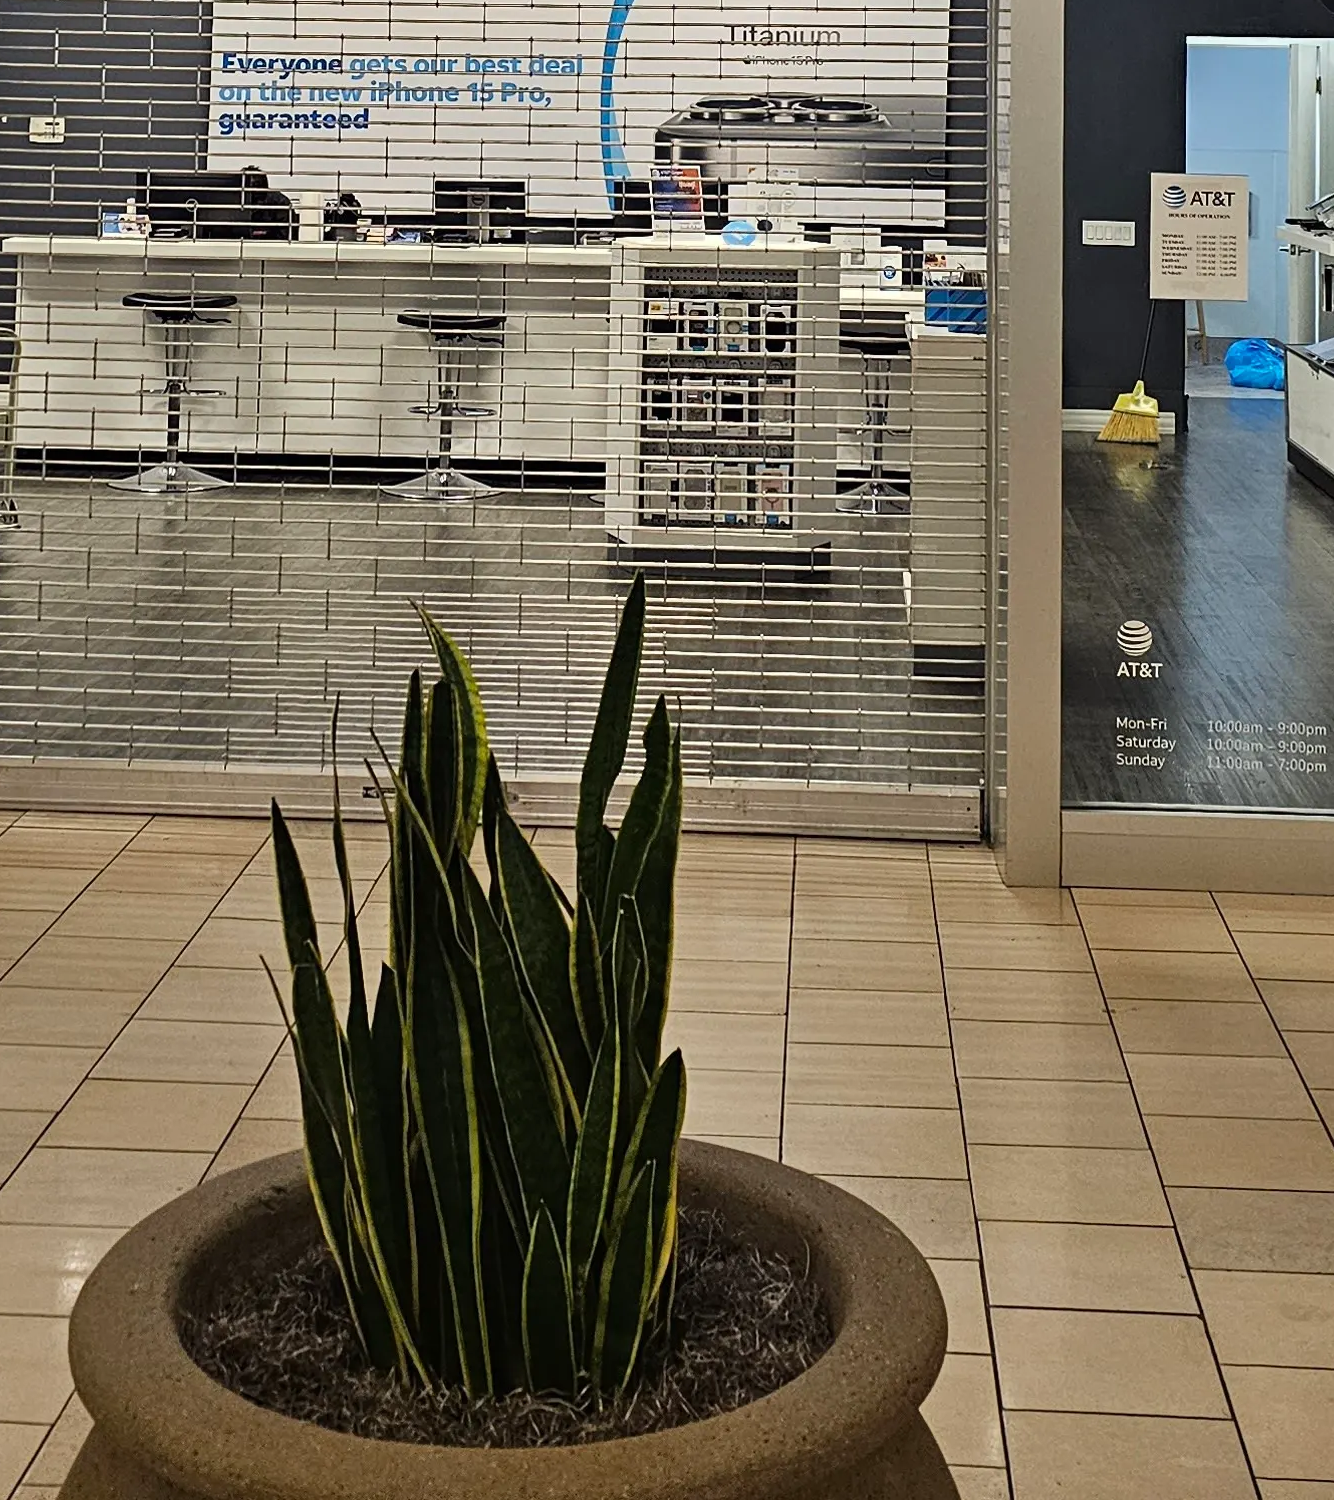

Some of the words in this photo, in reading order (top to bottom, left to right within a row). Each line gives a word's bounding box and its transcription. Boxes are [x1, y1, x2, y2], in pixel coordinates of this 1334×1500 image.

[221, 52, 342, 80] Everyone
[349, 54, 407, 80] gets
[413, 57, 458, 75] our
[466, 53, 522, 75] best
[528, 53, 584, 76] deal
[219, 84, 251, 102] on
[259, 80, 301, 102] the
[308, 85, 363, 102] new
[370, 79, 459, 102] iPhone
[466, 81, 493, 103] 15
[500, 81, 552, 107] Pro,
[219, 108, 370, 135] guaranteed
[1190, 191, 1236, 207] AT&T
[1117, 662, 1164, 678] AT&T
[1116, 717, 1167, 731] Mon-Fri
[1207, 720, 1263, 733] 10:00am
[1277, 721, 1327, 737] 9:00pm
[1116, 735, 1176, 751] Saturday
[1207, 738, 1263, 752] 10:00am
[1277, 740, 1327, 756] 9:00pm
[1116, 753, 1166, 770] Sunday
[1207, 756, 1263, 770] 11:00am
[1278, 758, 1327, 773] 7:00pm
